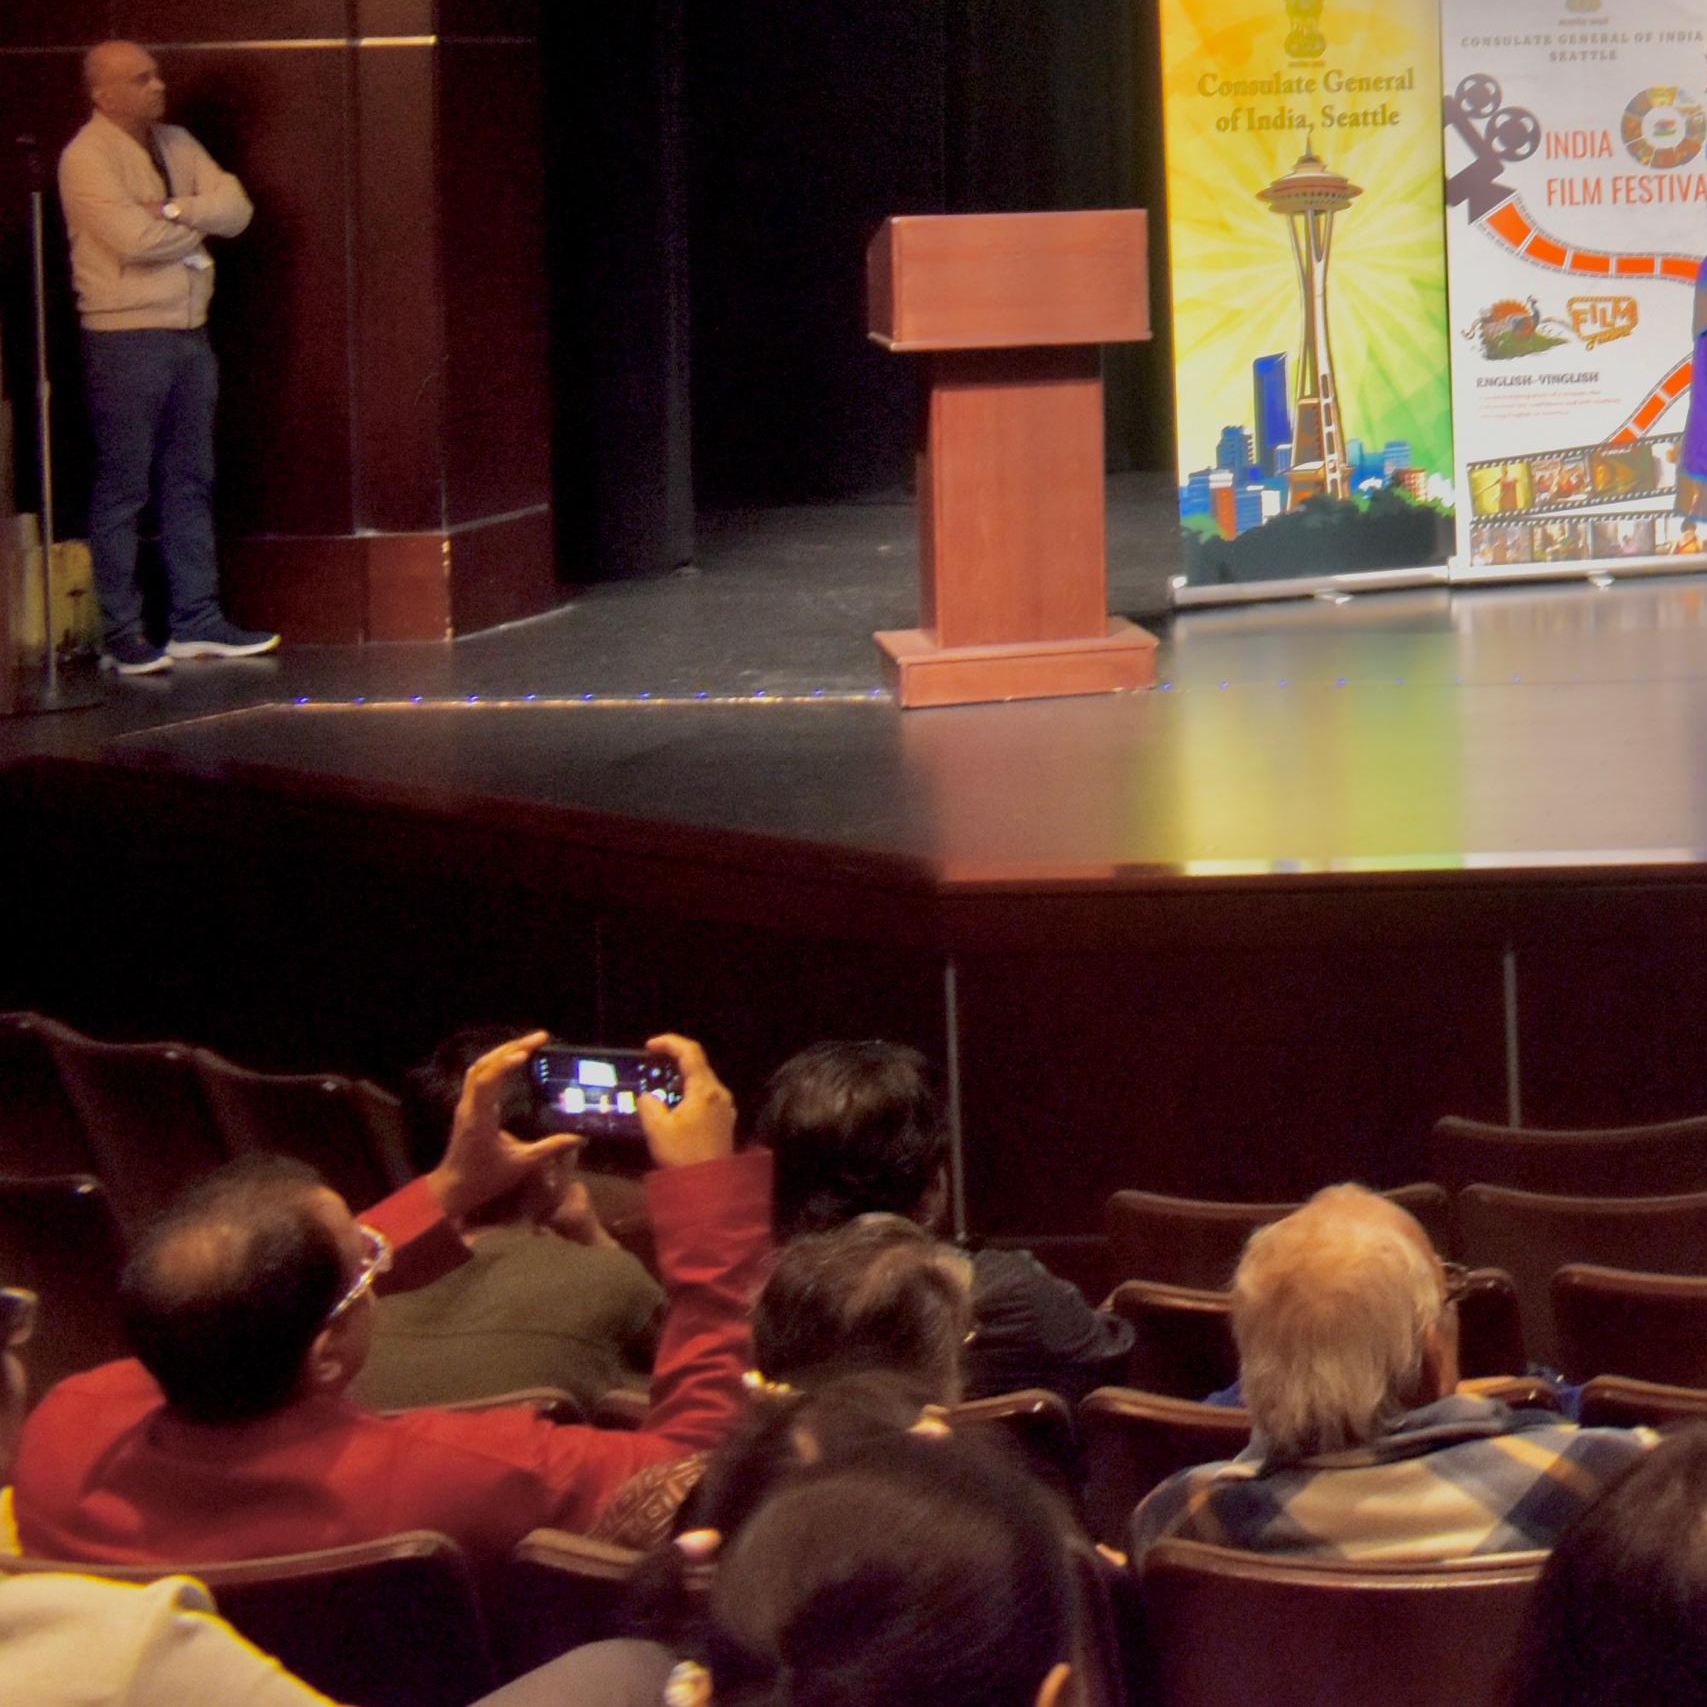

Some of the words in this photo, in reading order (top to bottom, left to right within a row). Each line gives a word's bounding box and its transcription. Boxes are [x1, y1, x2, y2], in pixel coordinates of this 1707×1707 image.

[1460, 34, 1552, 48] CONSULATE
[1557, 32, 1629, 45] GENERAL
[1634, 31, 1654, 43] OF
[1658, 30, 1703, 43] INDIA
[1549, 49, 1618, 62] SEATTLE
[1197, 71, 1317, 97] Consulate
[1323, 67, 1415, 93] General
[1215, 107, 1242, 133] of
[1246, 105, 1315, 134] India,
[1321, 103, 1401, 128] Seattle
[1545, 130, 1614, 160] INDIA
[1546, 176, 1603, 207] FILM
